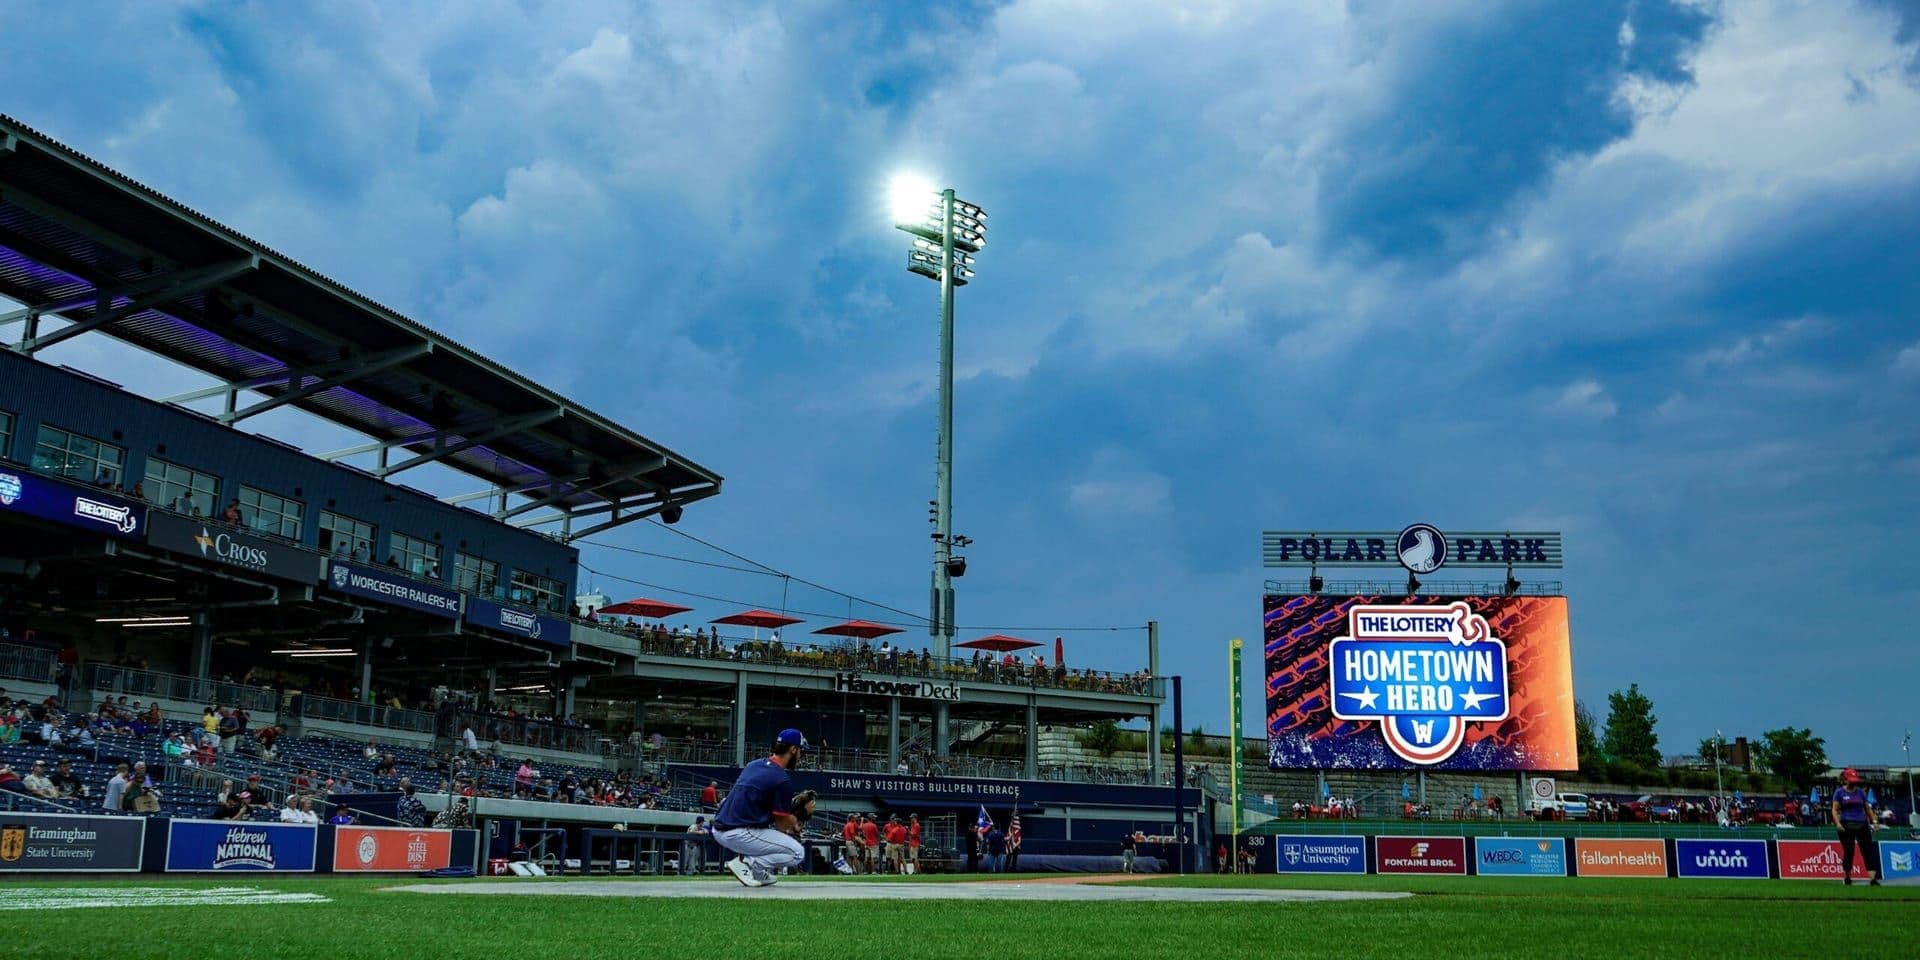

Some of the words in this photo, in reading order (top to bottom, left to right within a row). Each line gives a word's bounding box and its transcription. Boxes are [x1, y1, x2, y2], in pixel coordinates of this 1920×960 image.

[1279, 538, 1386, 561] POLAR
[1456, 538, 1547, 561] PARK
[350, 573, 407, 599] WORCESTER
[409, 589, 445, 608] RAILERS
[446, 598, 457, 611] HC
[1391, 617, 1455, 632] LOTTERY
[1344, 649, 1493, 682] HOMETOWN
[1386, 684, 1454, 711] HERO
[831, 778, 871, 789] SHAW'S
[875, 780, 925, 792] VISITORS
[929, 783, 973, 794] BULLPEN
[977, 784, 1020, 796] TERRACE
[29, 826, 96, 843] Framingham
[226, 827, 267, 844] Hebrew
[1248, 836, 1265, 846] 330
[26, 846, 49, 858] State
[51, 847, 95, 861] University
[216, 843, 272, 861] NATIONAL
[408, 842, 426, 851] STEEL
[1302, 844, 1359, 856] Assumption
[408, 851, 426, 861] DUST
[1303, 854, 1351, 865] University
[1384, 858, 1428, 867] FONTAINE
[1430, 859, 1457, 867] BROS.
[1483, 850, 1522, 863] WBDC
[1581, 850, 1662, 865] fallonhealth
[1790, 864, 1860, 873] SAINT-GOBN
